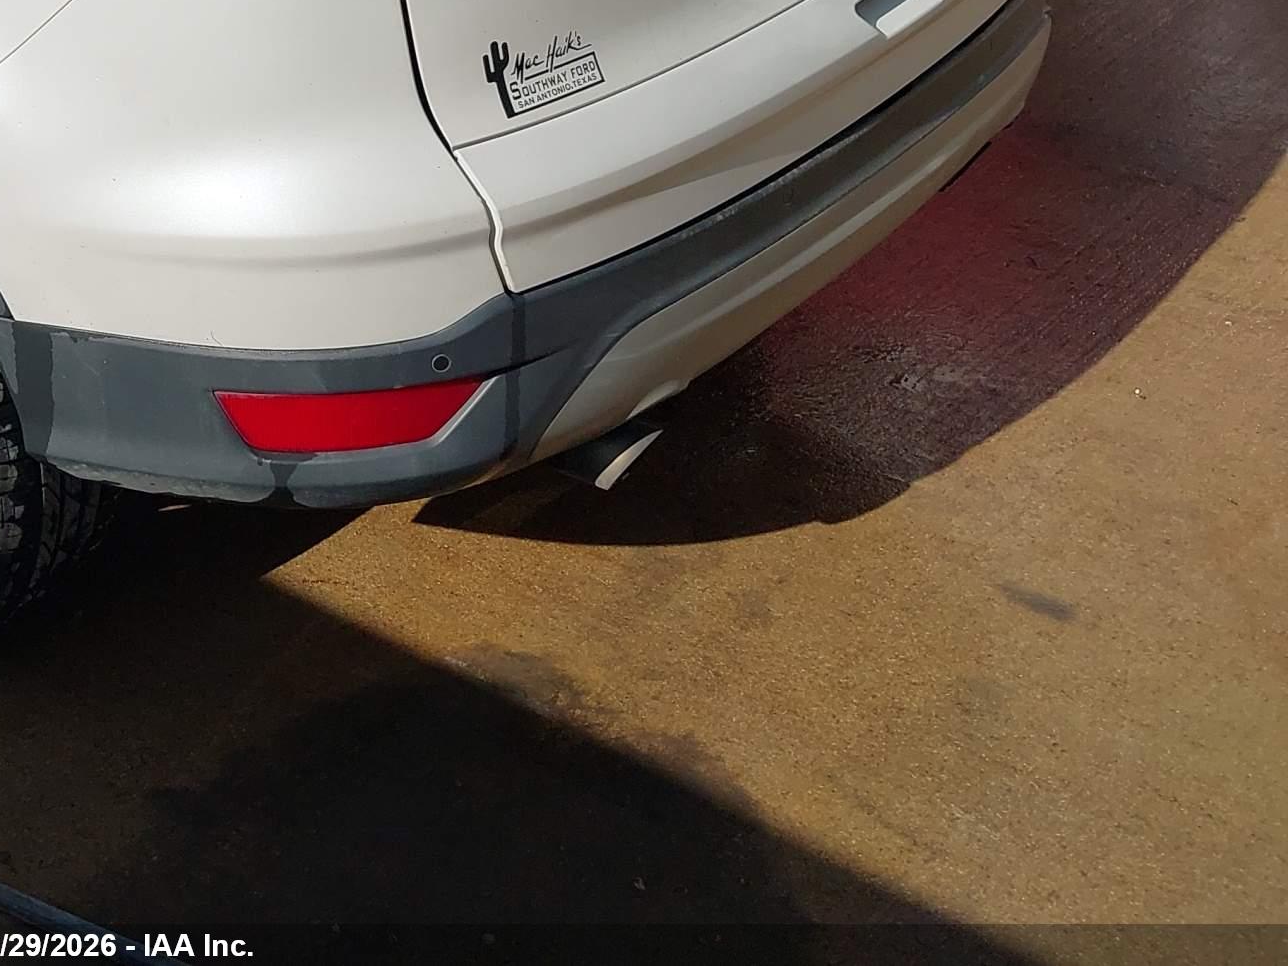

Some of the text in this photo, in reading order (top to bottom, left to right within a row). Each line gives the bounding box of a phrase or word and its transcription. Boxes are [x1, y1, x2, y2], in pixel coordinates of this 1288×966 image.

[510, 31, 592, 84] Mac Haik's
[509, 60, 596, 100] SOUTHWAY FORD
[517, 97, 536, 109] SAN
